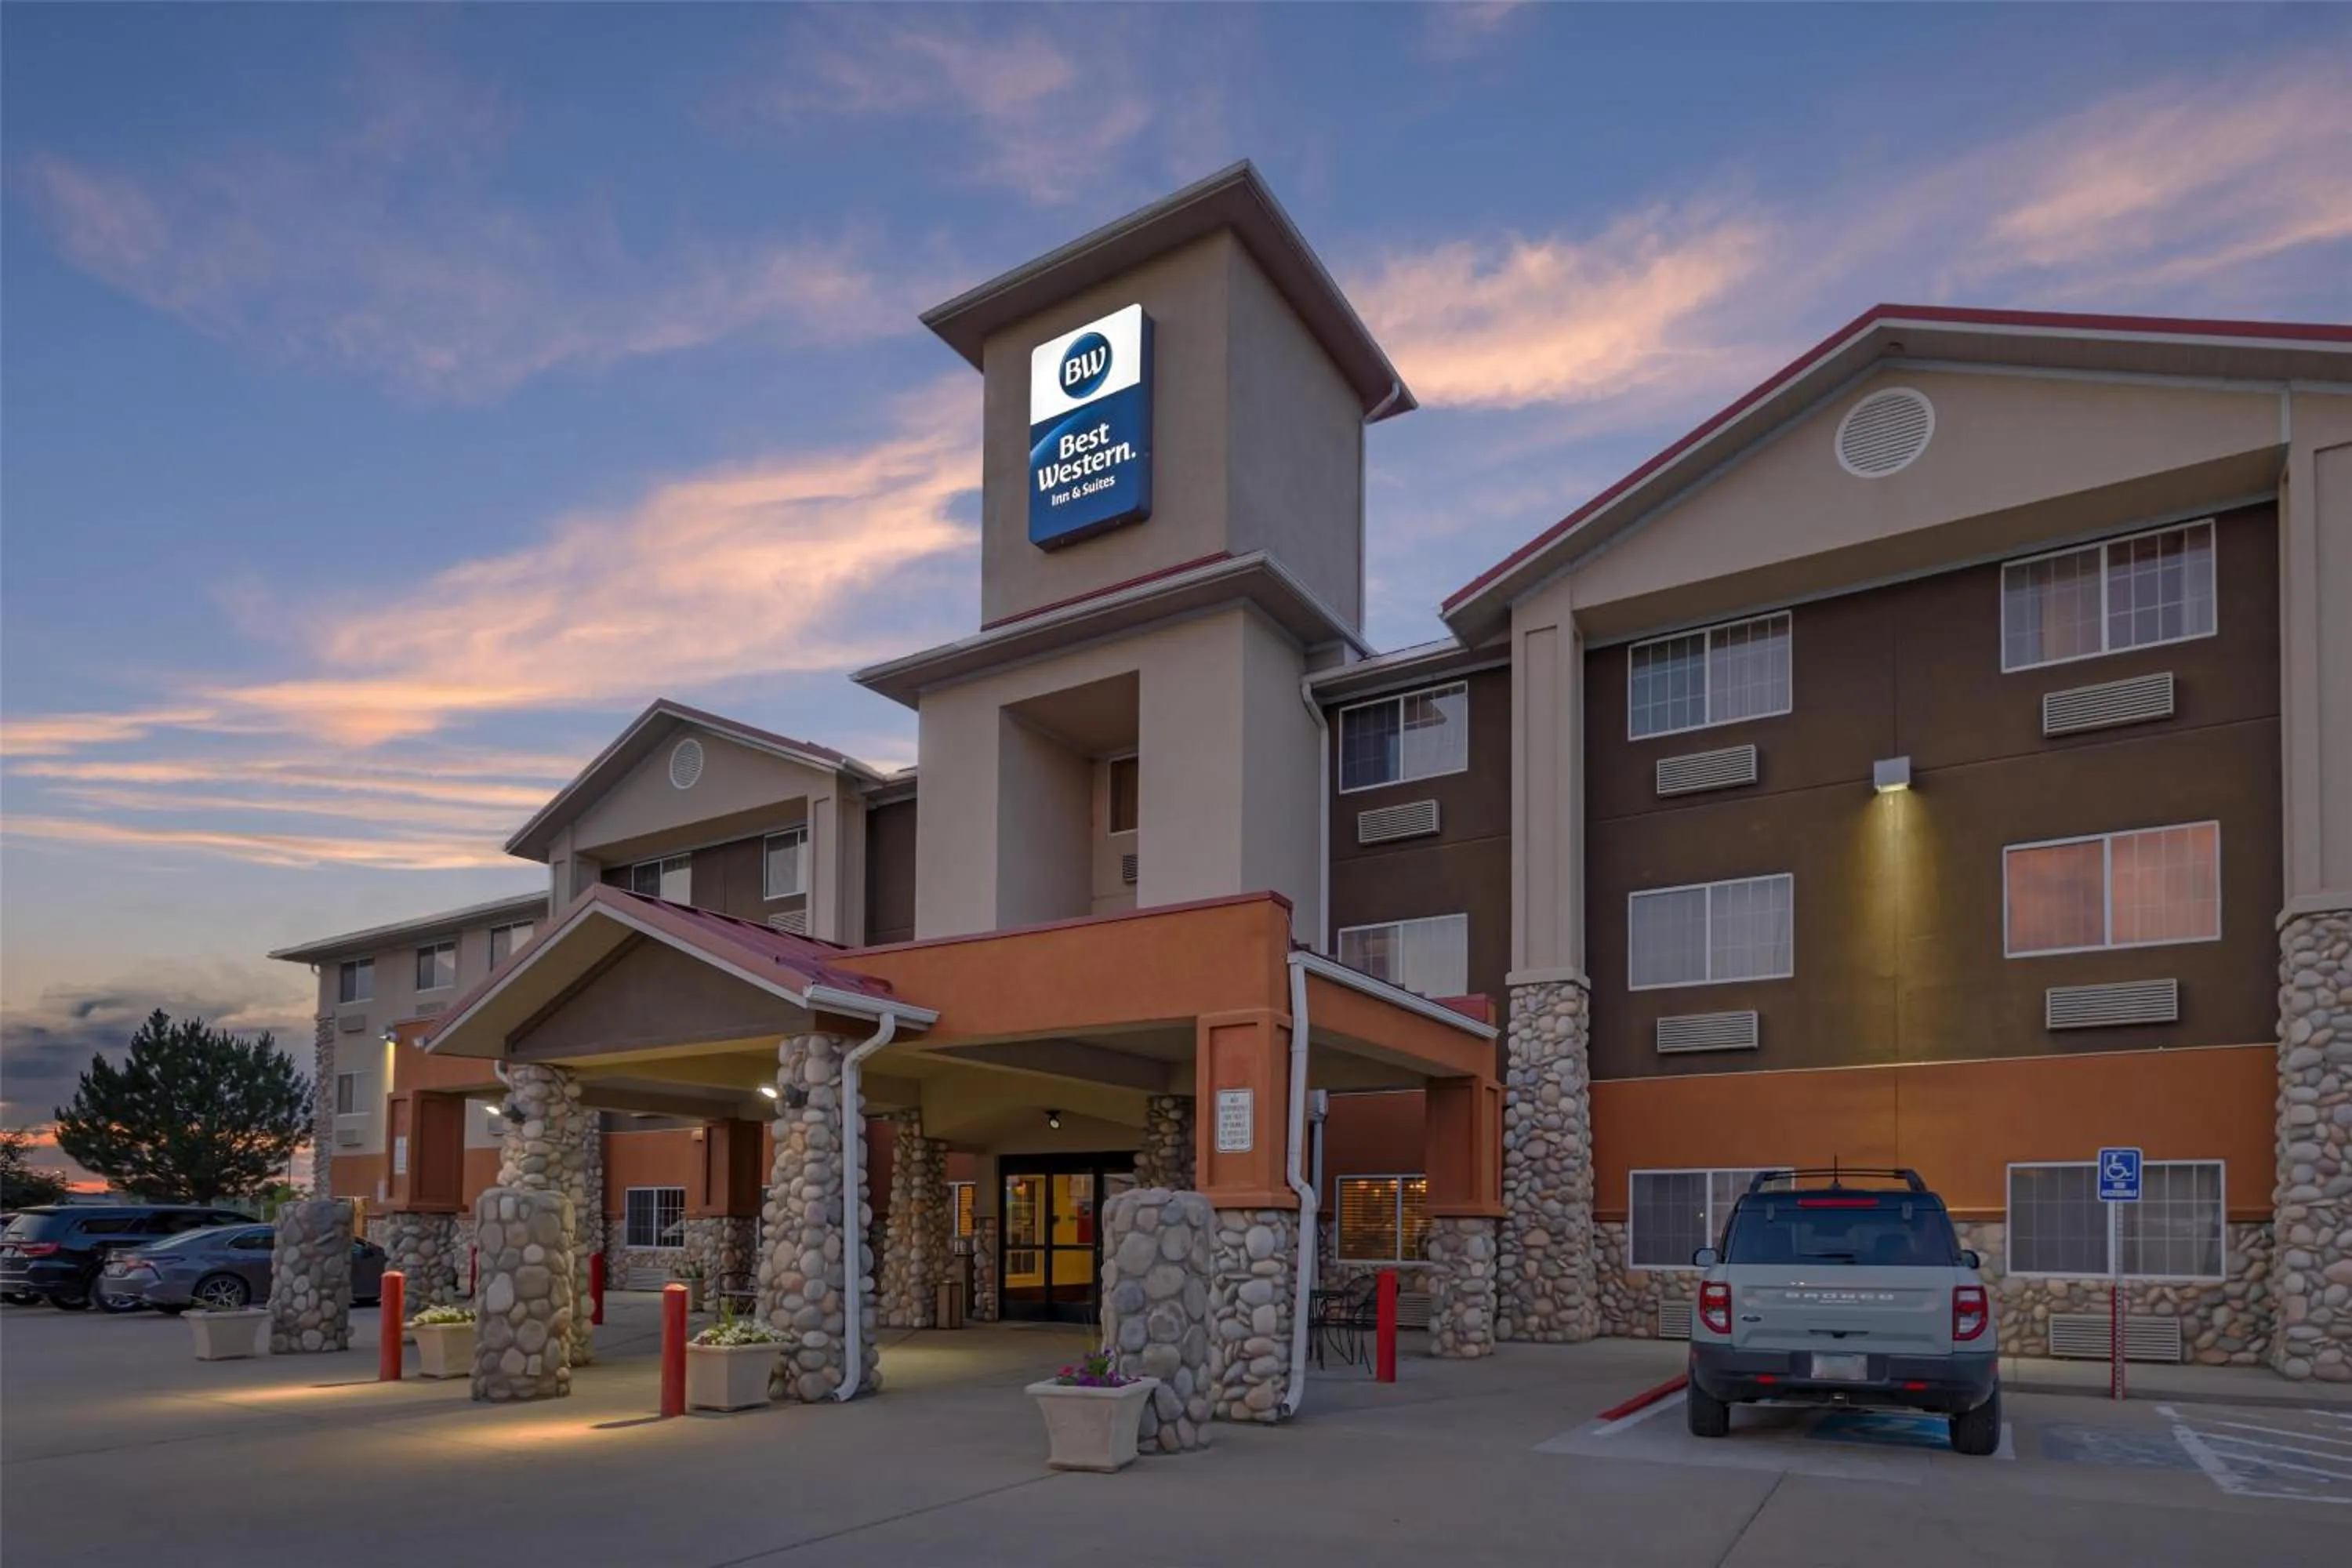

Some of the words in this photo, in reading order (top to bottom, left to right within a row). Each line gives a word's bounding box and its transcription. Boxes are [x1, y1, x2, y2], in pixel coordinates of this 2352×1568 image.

[1065, 346, 1106, 387] BW
[1059, 423, 1110, 460] Best
[1051, 492, 1070, 506] Inn
[1072, 485, 1081, 499] &
[1082, 474, 1116, 495] Suites
